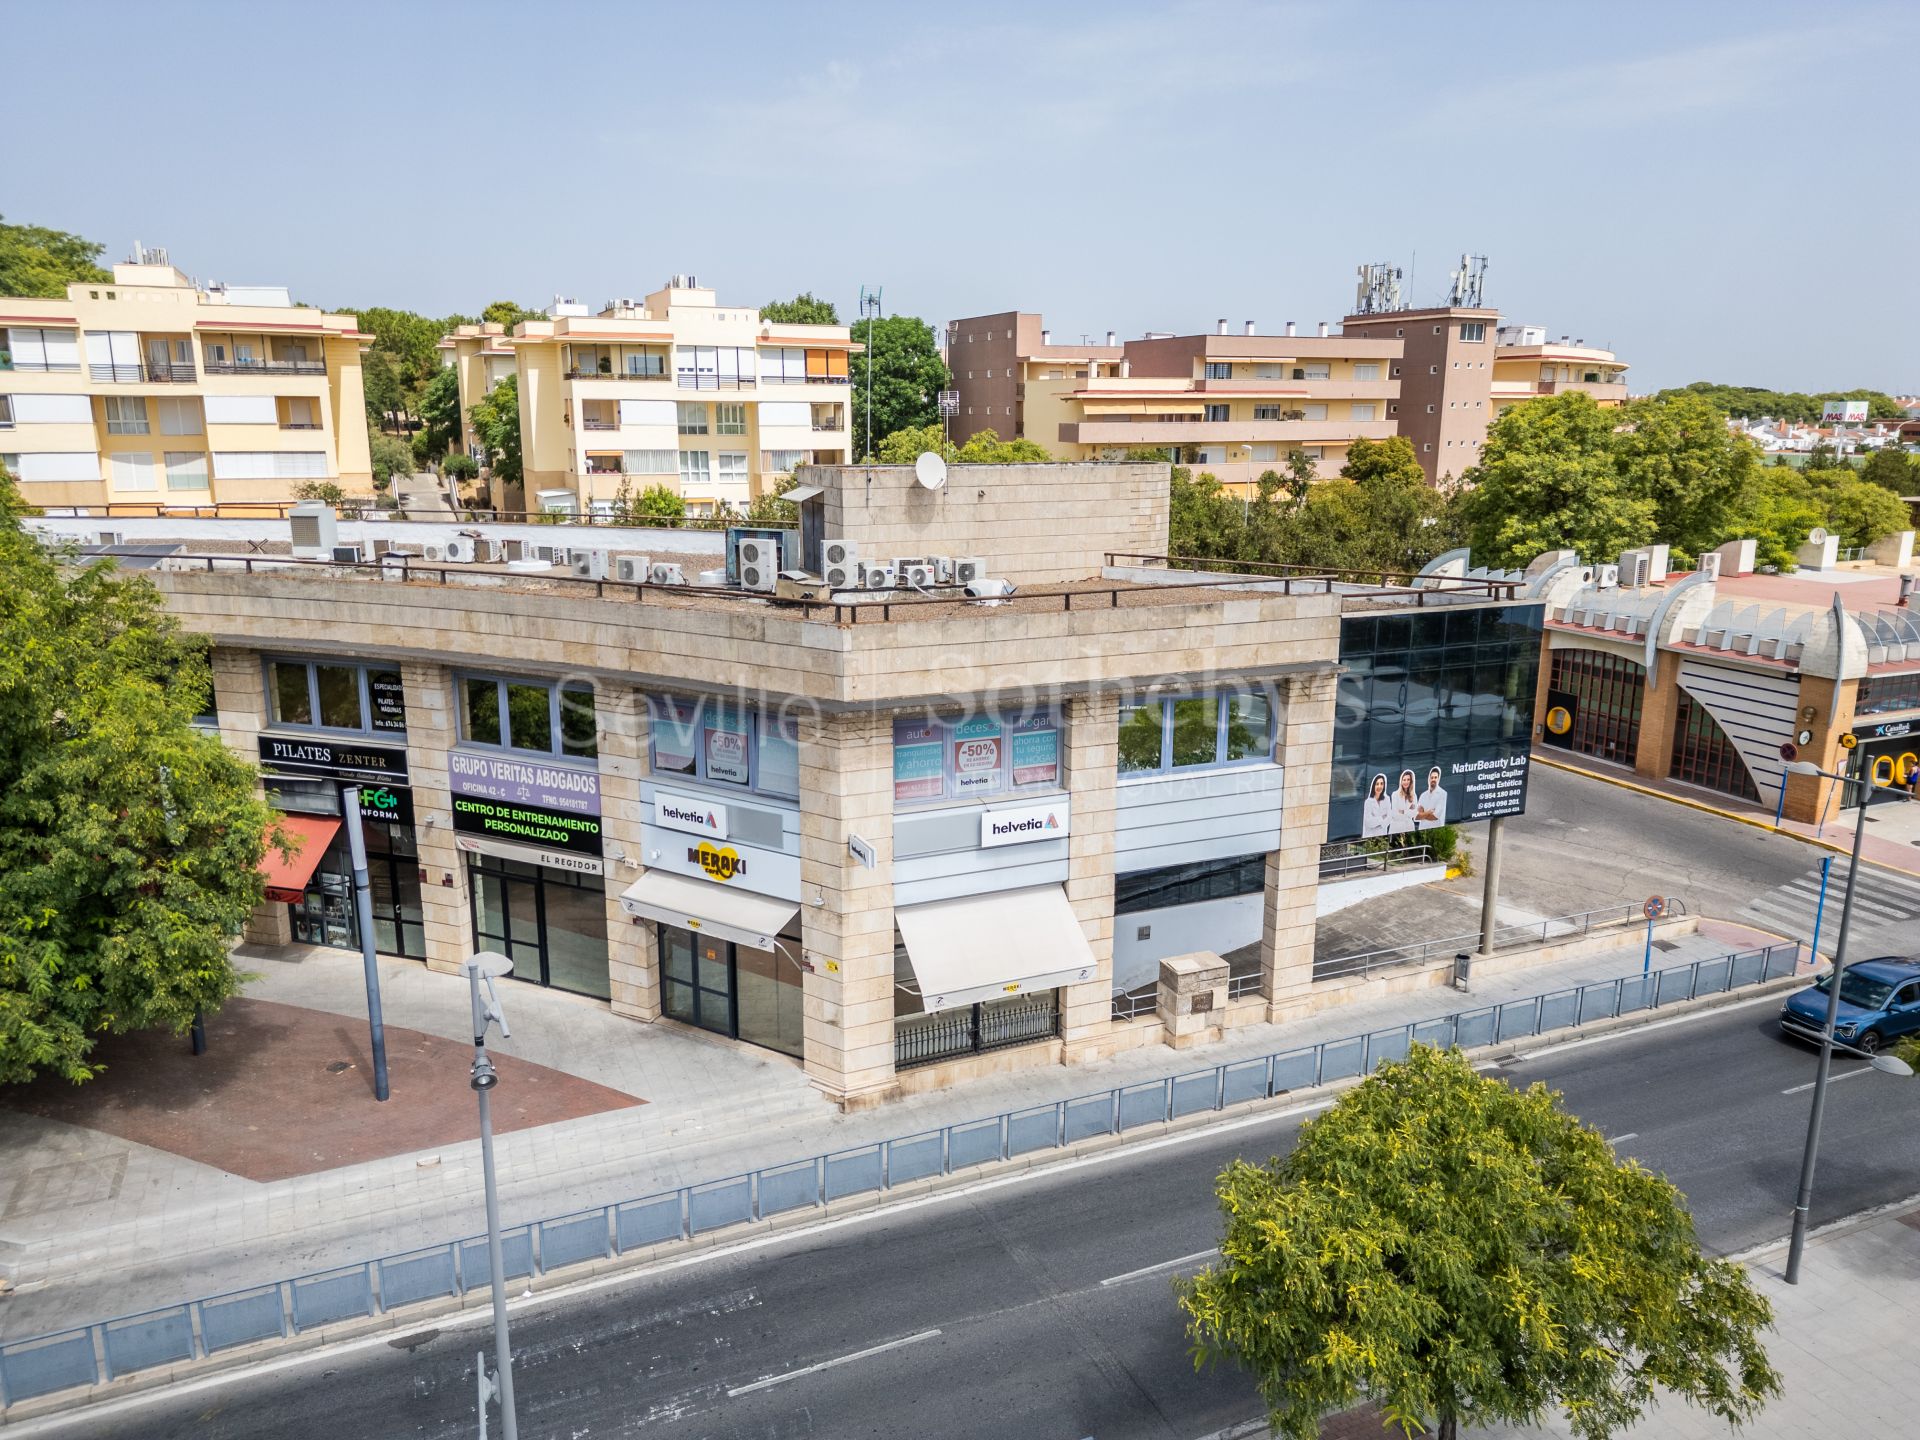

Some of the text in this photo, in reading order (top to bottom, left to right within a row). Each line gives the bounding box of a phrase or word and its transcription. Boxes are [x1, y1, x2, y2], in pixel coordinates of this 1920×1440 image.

[956, 721, 1000, 735] decesos
[1018, 716, 1050, 730] hogar
[906, 729, 932, 740] auto
[1013, 735, 1057, 746] ahorra con
[713, 735, 741, 750] -50%
[273, 743, 387, 768] PILATES ZENTER
[962, 743, 995, 757] -50%
[1015, 746, 1025, 754] tu
[906, 758, 942, 770] ahorro
[1013, 753, 1057, 766] de HOGAR
[1452, 755, 1527, 774] NaturBeauty Lab
[452, 755, 596, 795] GRUPO VERITAS ABOGADOS
[711, 764, 737, 777] helvetia
[1501, 769, 1524, 778] Capilar
[960, 777, 989, 786] helvetia
[1466, 779, 1523, 793] Medicina Estética
[462, 782, 488, 796] OFICINA
[488, 787, 497, 796] 42
[1484, 791, 1496, 800] 954
[360, 808, 399, 820] NFORMA
[455, 800, 599, 834] CENTRO DE ENTRENAMIENTO
[663, 805, 704, 824] helvetia
[484, 818, 569, 843] PERSONALIZADO
[992, 819, 1043, 835] helvetia
[541, 854, 598, 872] EL REGIDOR
[687, 847, 747, 878] MERAKI
